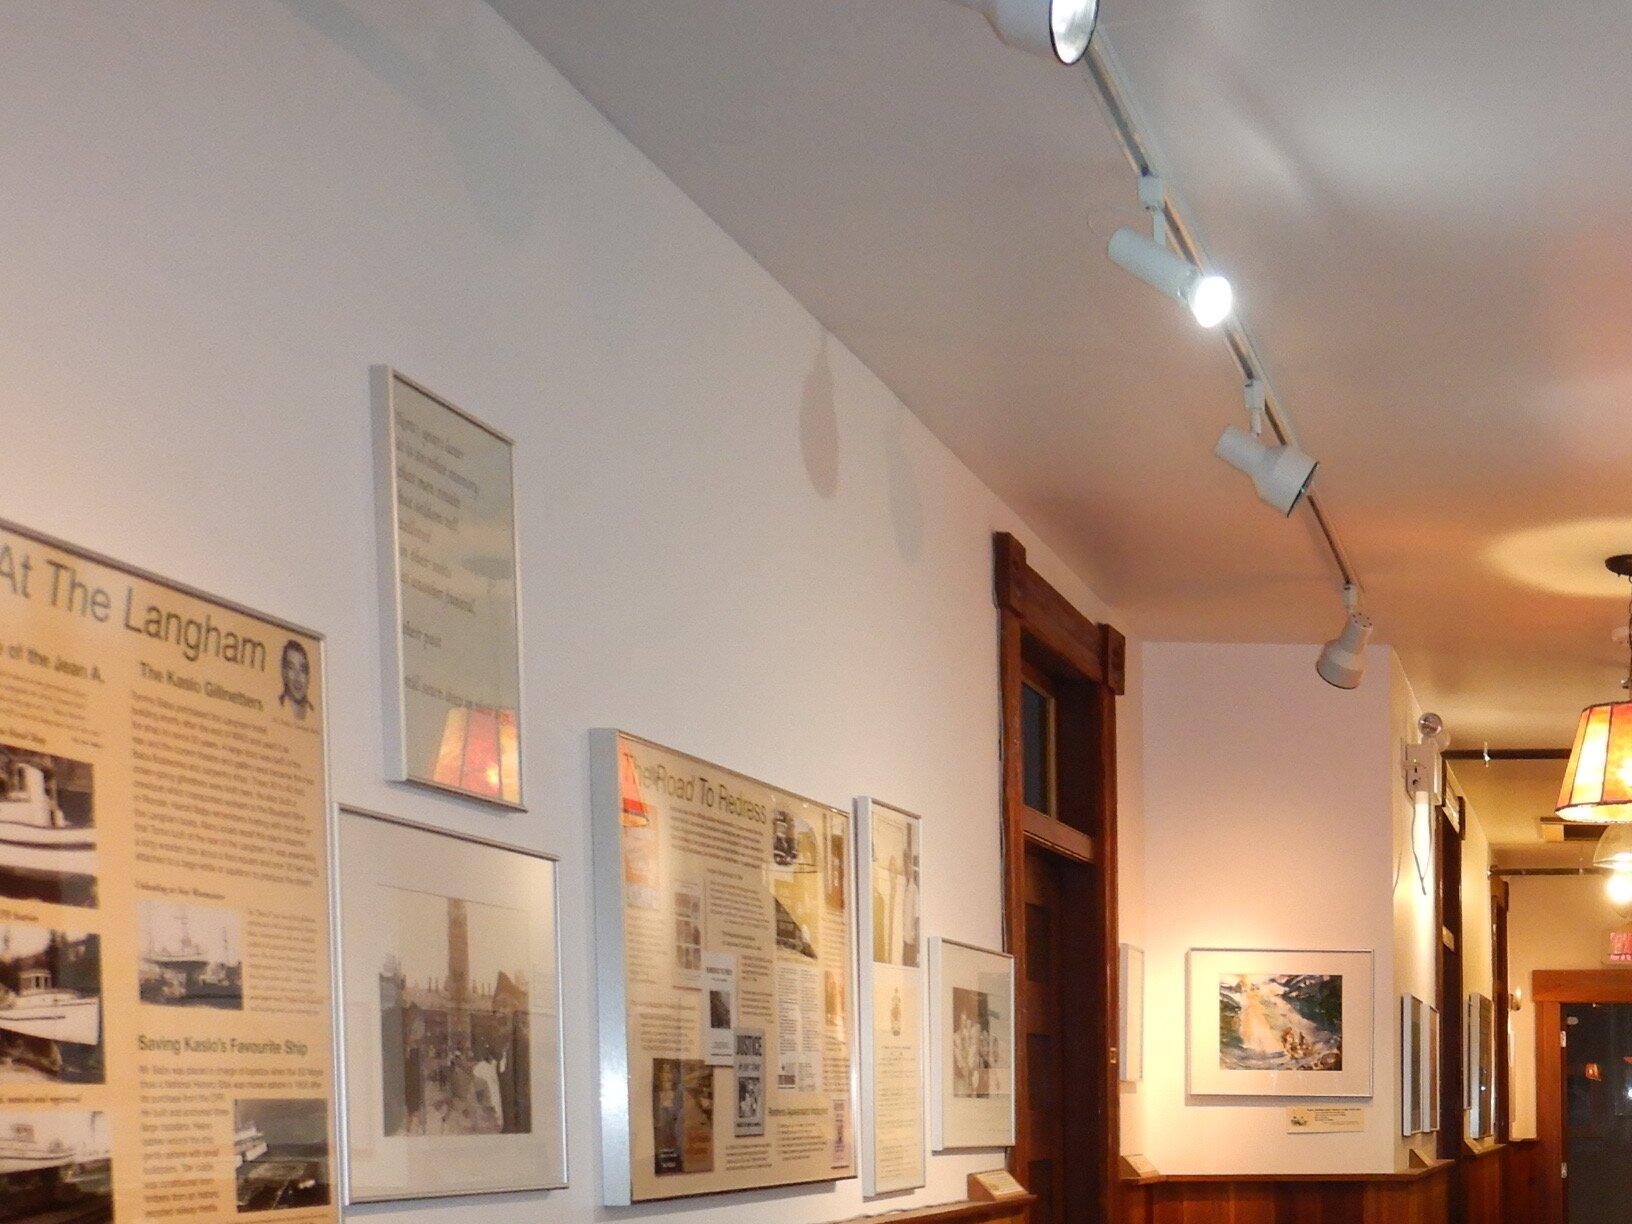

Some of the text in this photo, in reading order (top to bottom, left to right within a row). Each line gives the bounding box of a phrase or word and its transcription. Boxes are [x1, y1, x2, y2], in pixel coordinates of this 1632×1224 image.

[0, 543, 267, 672] At The Langham
[140, 660, 164, 684] The
[655, 763, 697, 802] Road
[699, 776, 715, 808] To
[718, 783, 767, 825] Redress
[136, 1033, 181, 1056] Saving
[229, 1036, 282, 1054] Favourite
[283, 1038, 309, 1056] Ship
